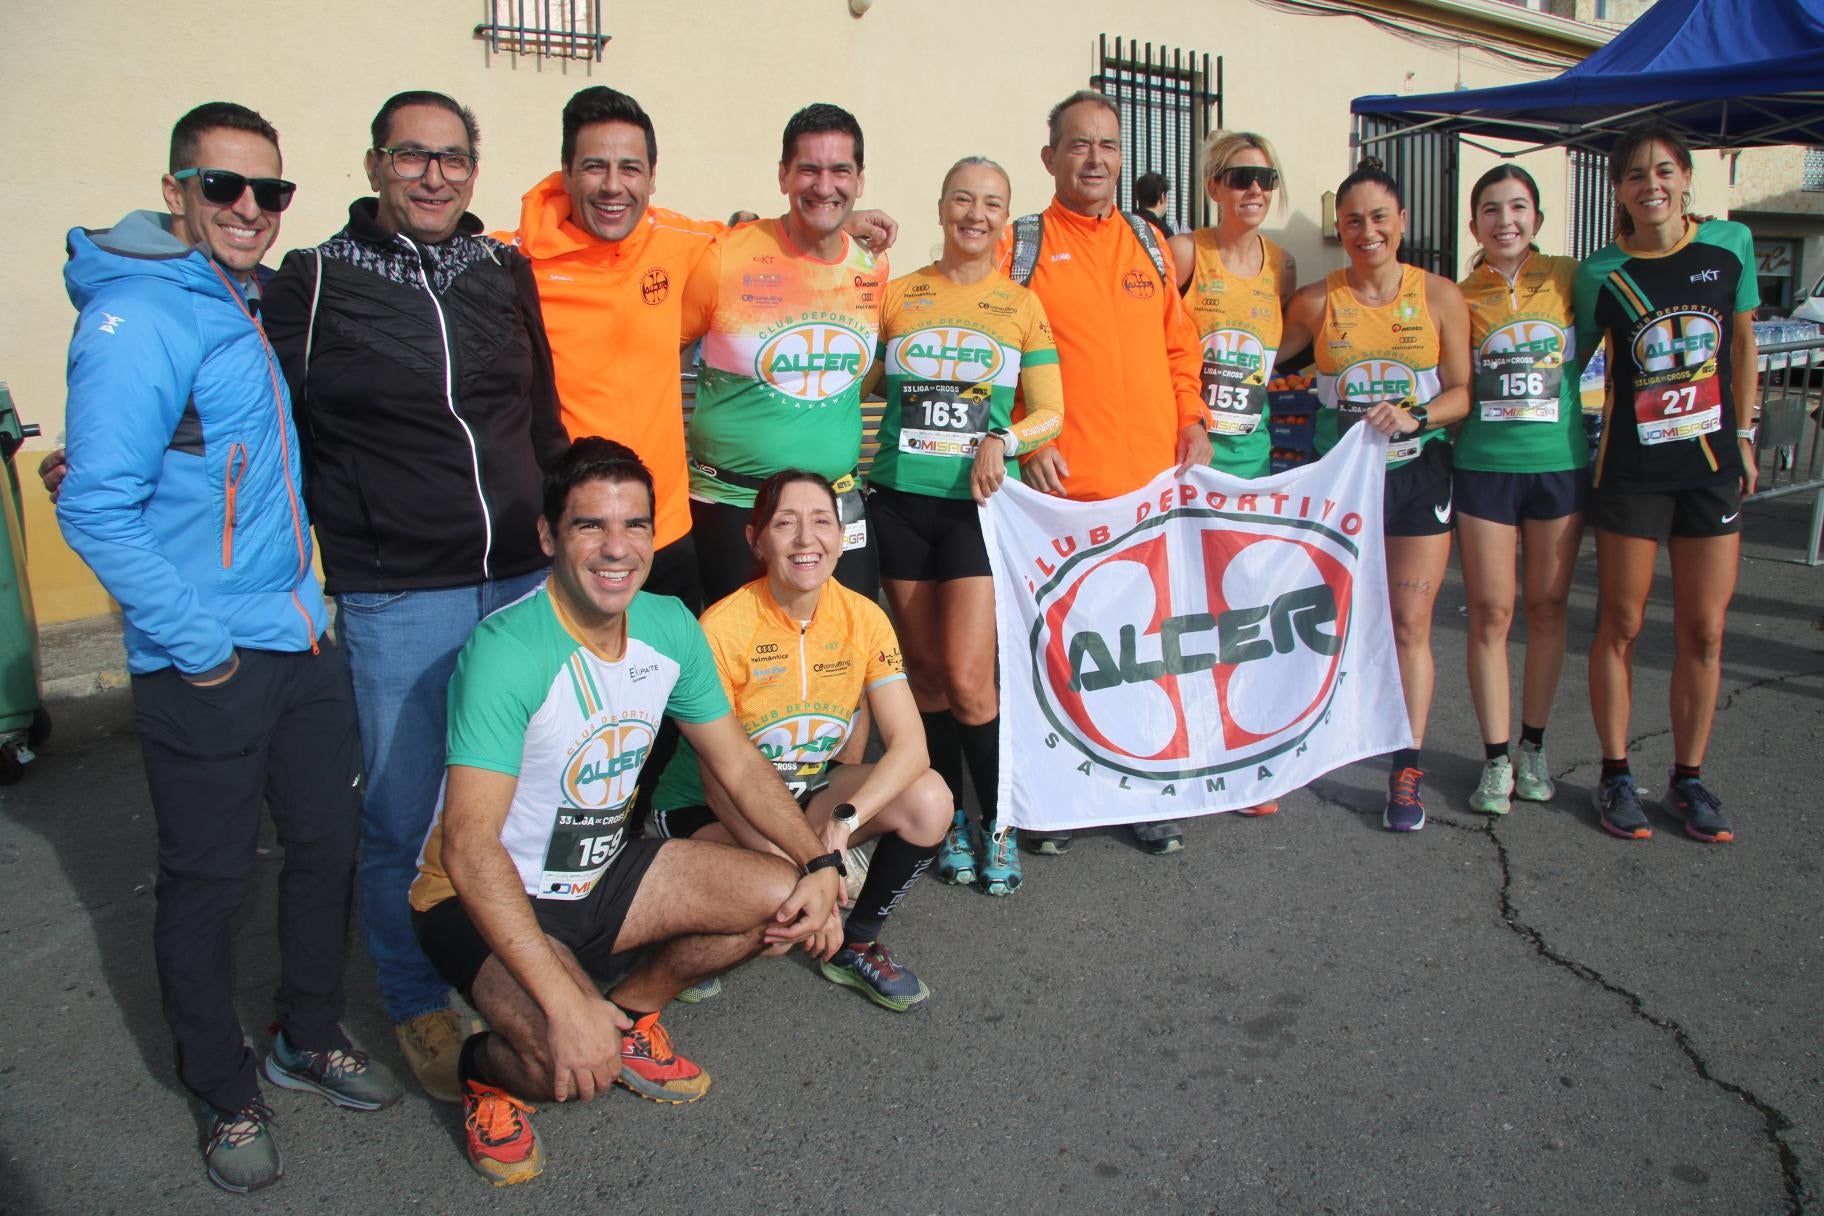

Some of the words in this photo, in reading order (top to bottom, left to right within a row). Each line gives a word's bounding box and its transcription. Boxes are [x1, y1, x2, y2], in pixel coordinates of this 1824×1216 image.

[1656, 304, 1724, 322] DEPORTIVO
[759, 316, 794, 340] CLUB
[801, 311, 871, 340] DEPORTIVO
[905, 343, 994, 369] ALCER
[1645, 332, 1716, 359] ALCER
[769, 353, 861, 376] ALCER
[1203, 347, 1261, 370] ALCER
[1511, 356, 1534, 364] CROSS
[1204, 367, 1217, 375] LIGA
[1222, 369, 1244, 379] CROSS
[1500, 372, 1544, 397] 156
[1643, 376, 1660, 385] LIGA
[1666, 370, 1692, 381] CROSS
[902, 385, 912, 393] 33
[913, 385, 930, 393] LIGA
[936, 385, 960, 393] CROSS
[1208, 383, 1250, 411] 153
[1344, 380, 1410, 397] ALCER
[1662, 385, 1697, 415] 27
[922, 400, 969, 429] 163
[1643, 417, 1719, 441] JOMISAGA
[1024, 525, 1111, 594] LUB
[1136, 484, 1363, 537] DEPORTIVO
[1068, 583, 1342, 692] ALCER
[744, 710, 779, 732] CLUB
[575, 745, 649, 785] ALCER
[560, 815, 573, 825] 33
[579, 827, 624, 867] 159
